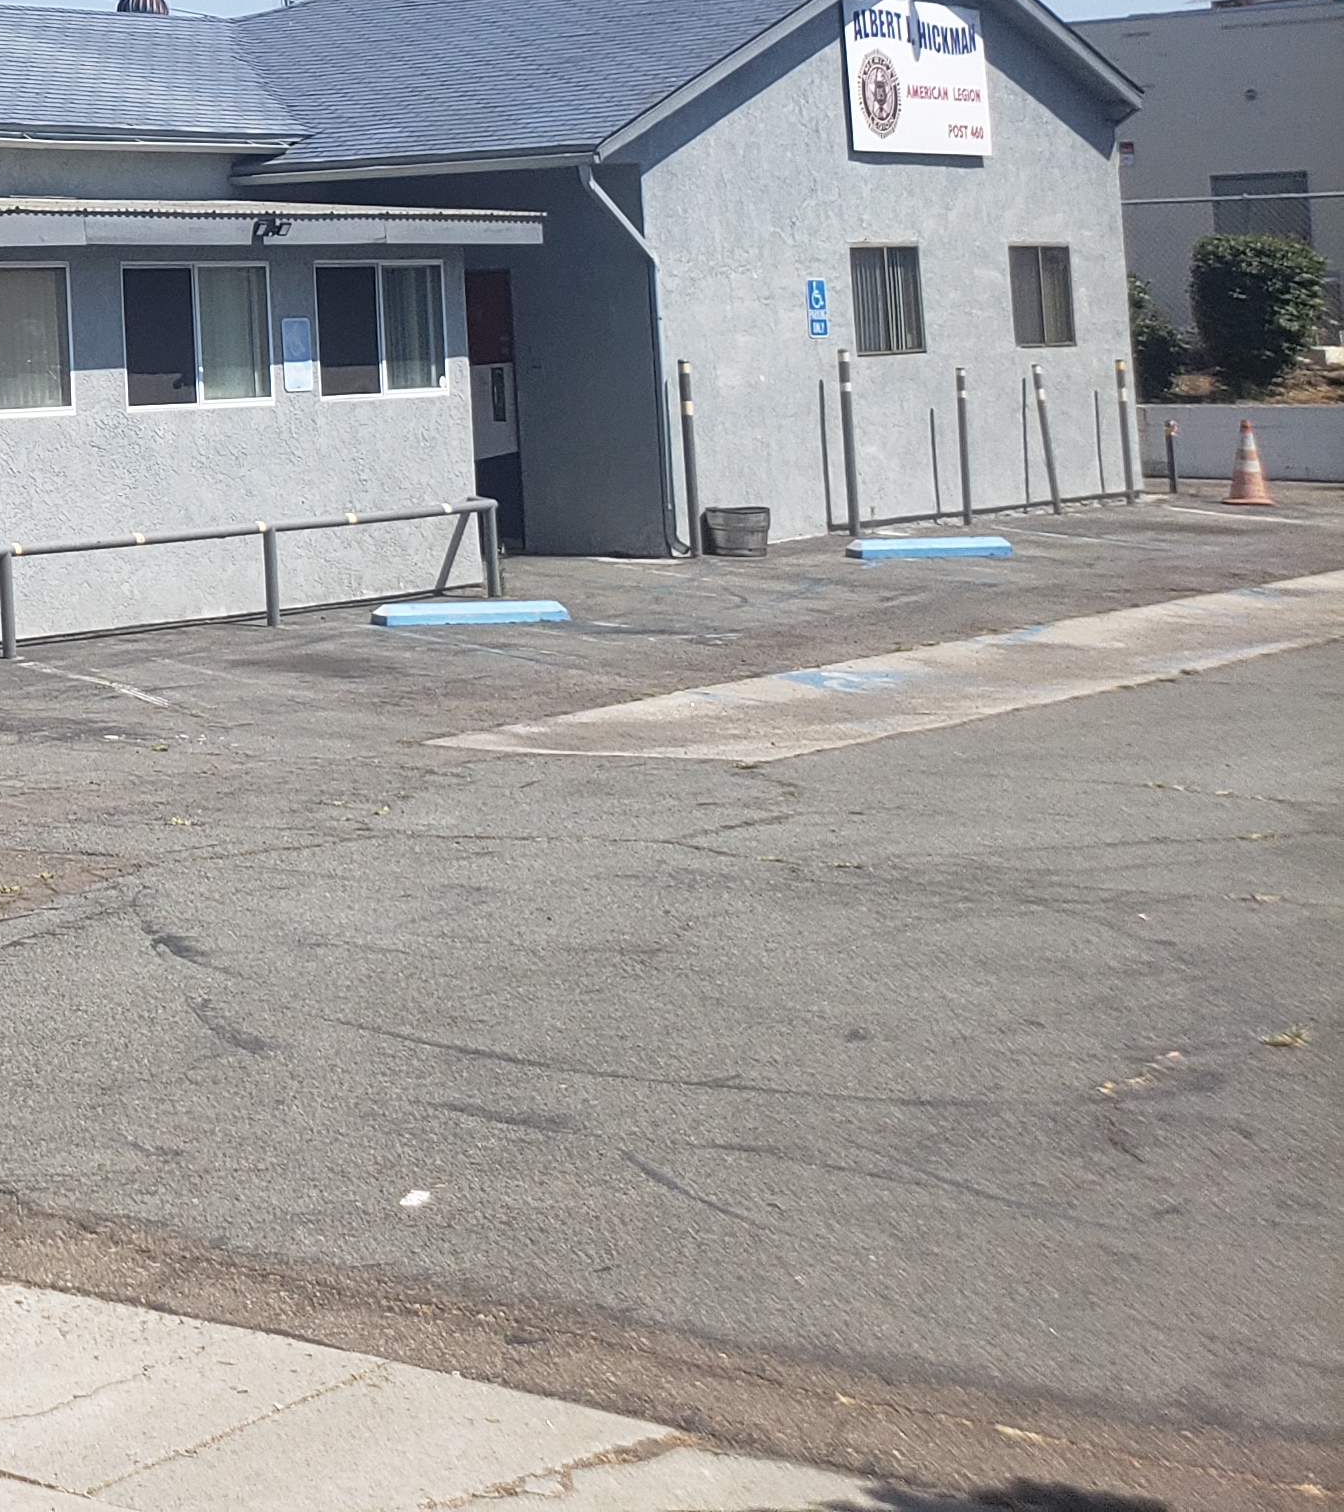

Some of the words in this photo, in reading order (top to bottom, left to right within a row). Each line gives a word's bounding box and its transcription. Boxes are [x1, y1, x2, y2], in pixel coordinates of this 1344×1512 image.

[853, 9, 901, 42] ALBERT
[918, 17, 977, 55] HICKMAN
[906, 84, 949, 102] AMERICAN
[953, 86, 981, 103] LEGION
[948, 124, 968, 139] POST
[970, 125, 984, 140] 460
